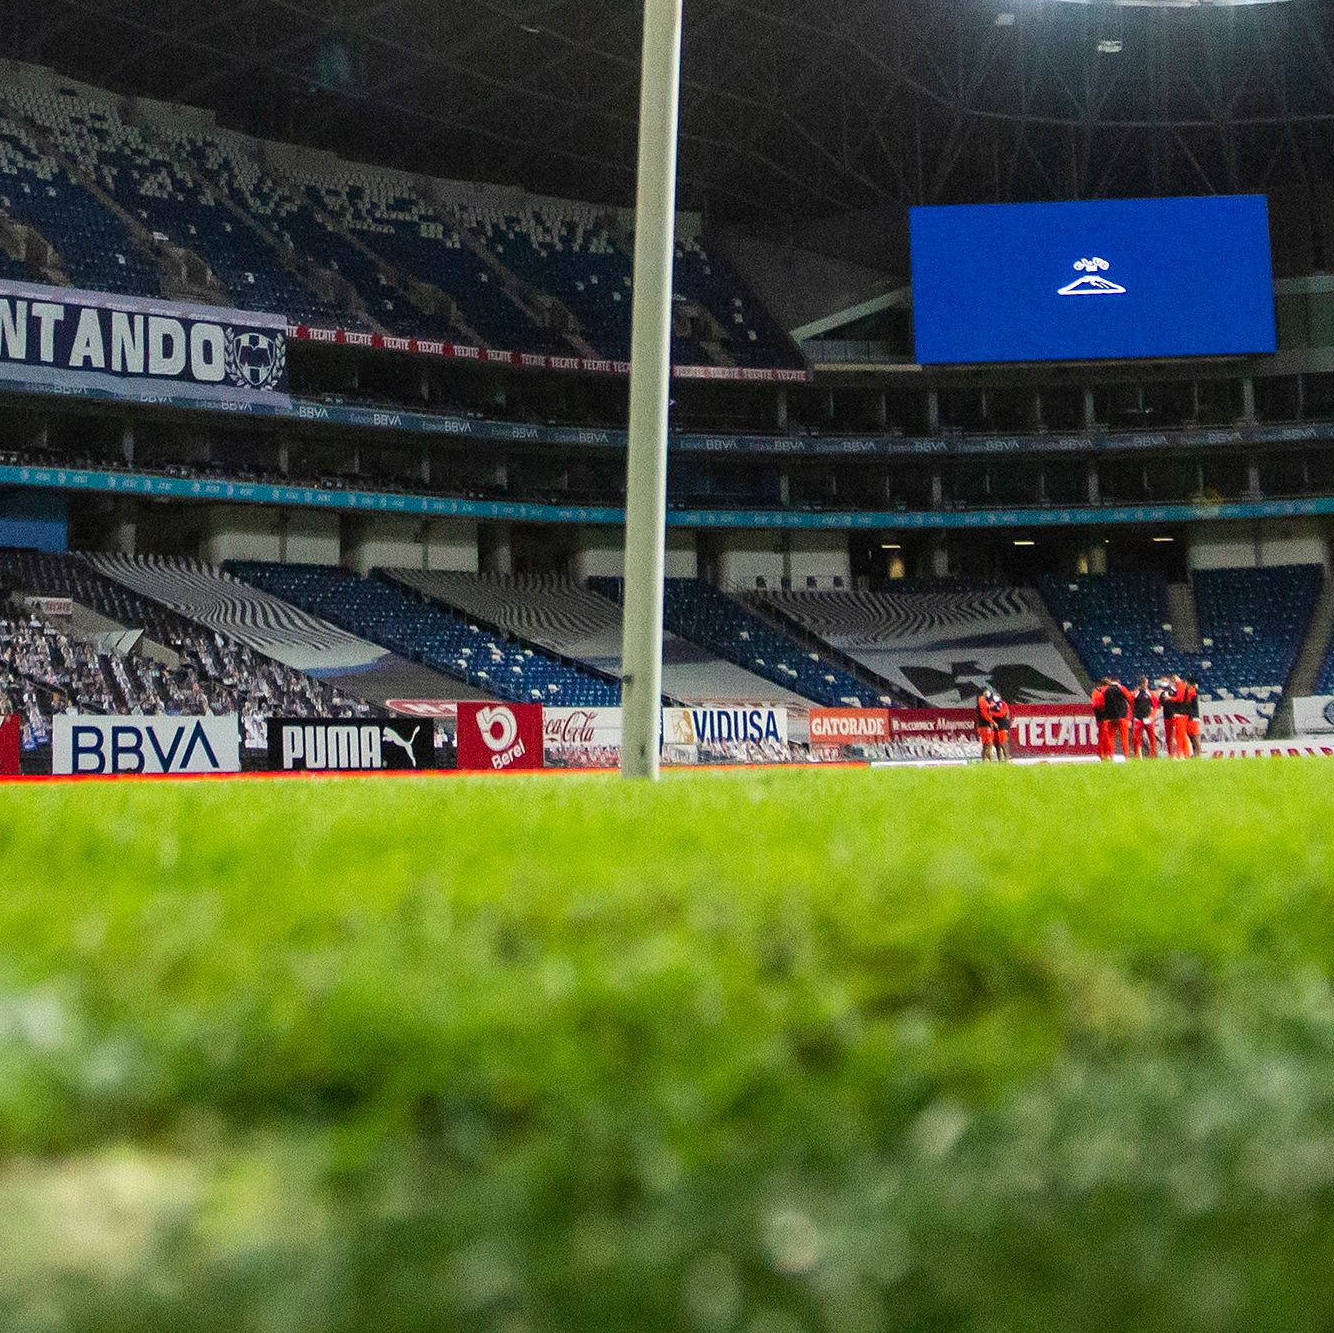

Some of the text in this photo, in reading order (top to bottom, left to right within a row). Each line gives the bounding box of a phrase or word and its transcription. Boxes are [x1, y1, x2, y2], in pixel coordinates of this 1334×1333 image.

[308, 327, 337, 343] TECATE
[344, 331, 372, 345] TECATE
[382, 335, 410, 351] TECATE
[417, 340, 444, 354] TECATE
[299, 406, 329, 419] BBVA
[373, 413, 402, 426] BBVA
[444, 421, 472, 433] BBVA
[693, 710, 780, 745] VIDUSA
[811, 717, 885, 736] GATORADE
[72, 720, 221, 774] BBVA
[283, 725, 385, 770] PUMA
[491, 737, 526, 770] Berel
